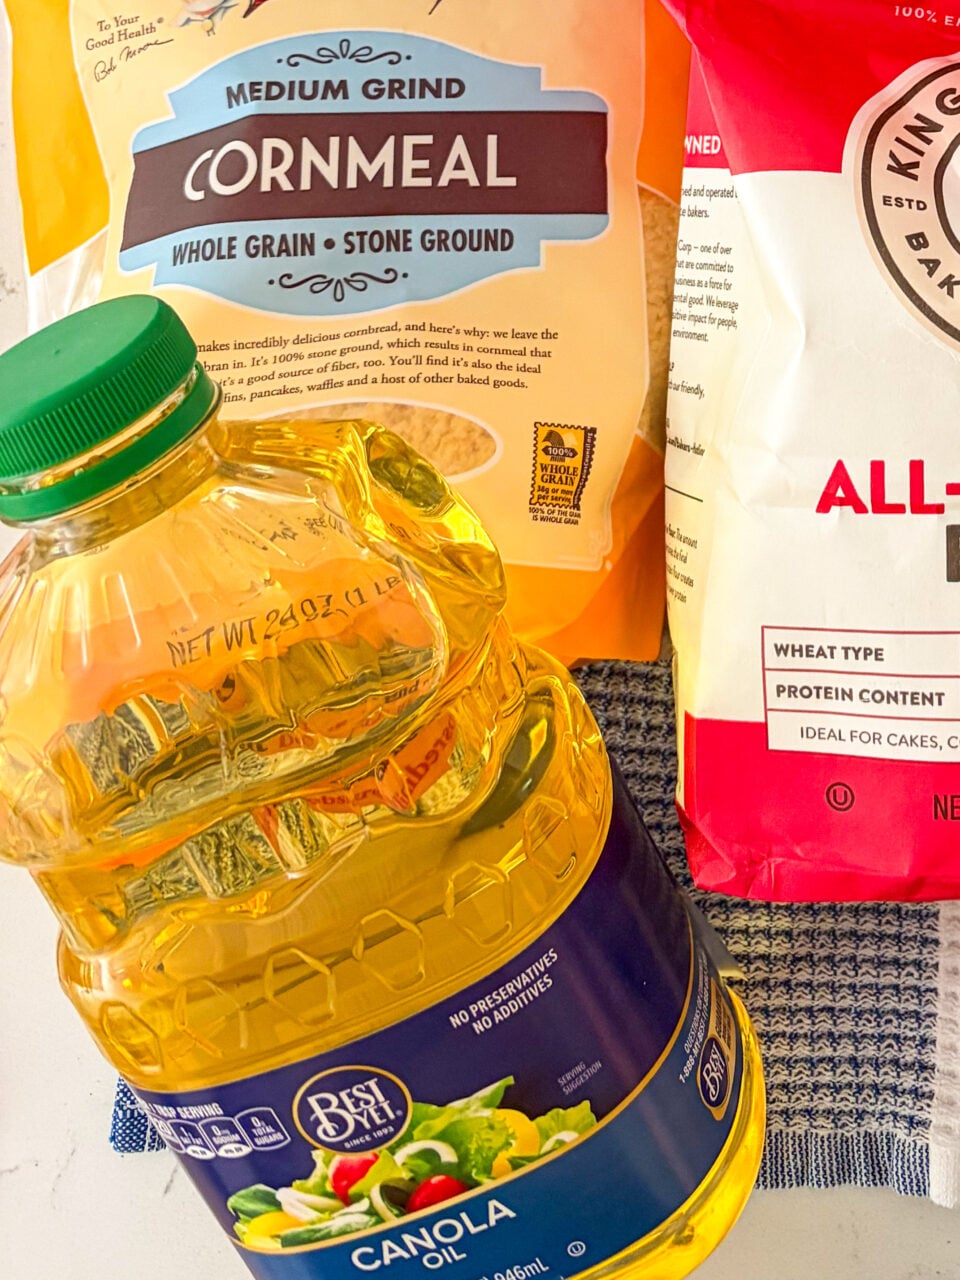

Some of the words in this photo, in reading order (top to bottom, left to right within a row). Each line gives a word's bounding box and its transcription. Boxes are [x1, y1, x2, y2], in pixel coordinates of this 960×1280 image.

[227, 79, 349, 109] MEDIUM
[361, 78, 466, 100] GRIND
[183, 134, 517, 201] CORNMEAL
[882, 195, 928, 212] ESTD
[172, 236, 236, 266] WHOLE
[244, 232, 316, 260] GRAIN
[344, 231, 412, 255] STONE
[421, 229, 514, 252] GROUND
[234, 335, 290, 350] incredibly
[292, 333, 340, 346] delicious
[343, 322, 401, 339] cornbread,
[405, 322, 426, 331] and
[430, 323, 461, 335] here's
[463, 327, 490, 340] why:
[493, 331, 508, 339] we
[511, 328, 538, 340] leave
[541, 328, 559, 340] the
[774, 643, 837, 660] WHEAT
[841, 646, 885, 662] TYPE
[776, 684, 853, 702] PROTEIN
[858, 688, 945, 707] CONTENT
[449, 1010, 470, 1029] NO
[469, 948, 558, 1018] PRESERVATIVES
[472, 1016, 492, 1035] NO
[493, 974, 553, 1024] ADDITIVES
[557, 1061, 586, 1086] SERVING
[562, 1060, 602, 1096] SUGGESTION
[307, 1078, 386, 1142] BEST
[351, 1100, 395, 1130] YET
[344, 1134, 371, 1149] SINCE
[351, 1199, 517, 1271] CANOLA
[422, 1245, 467, 1269] OIL
